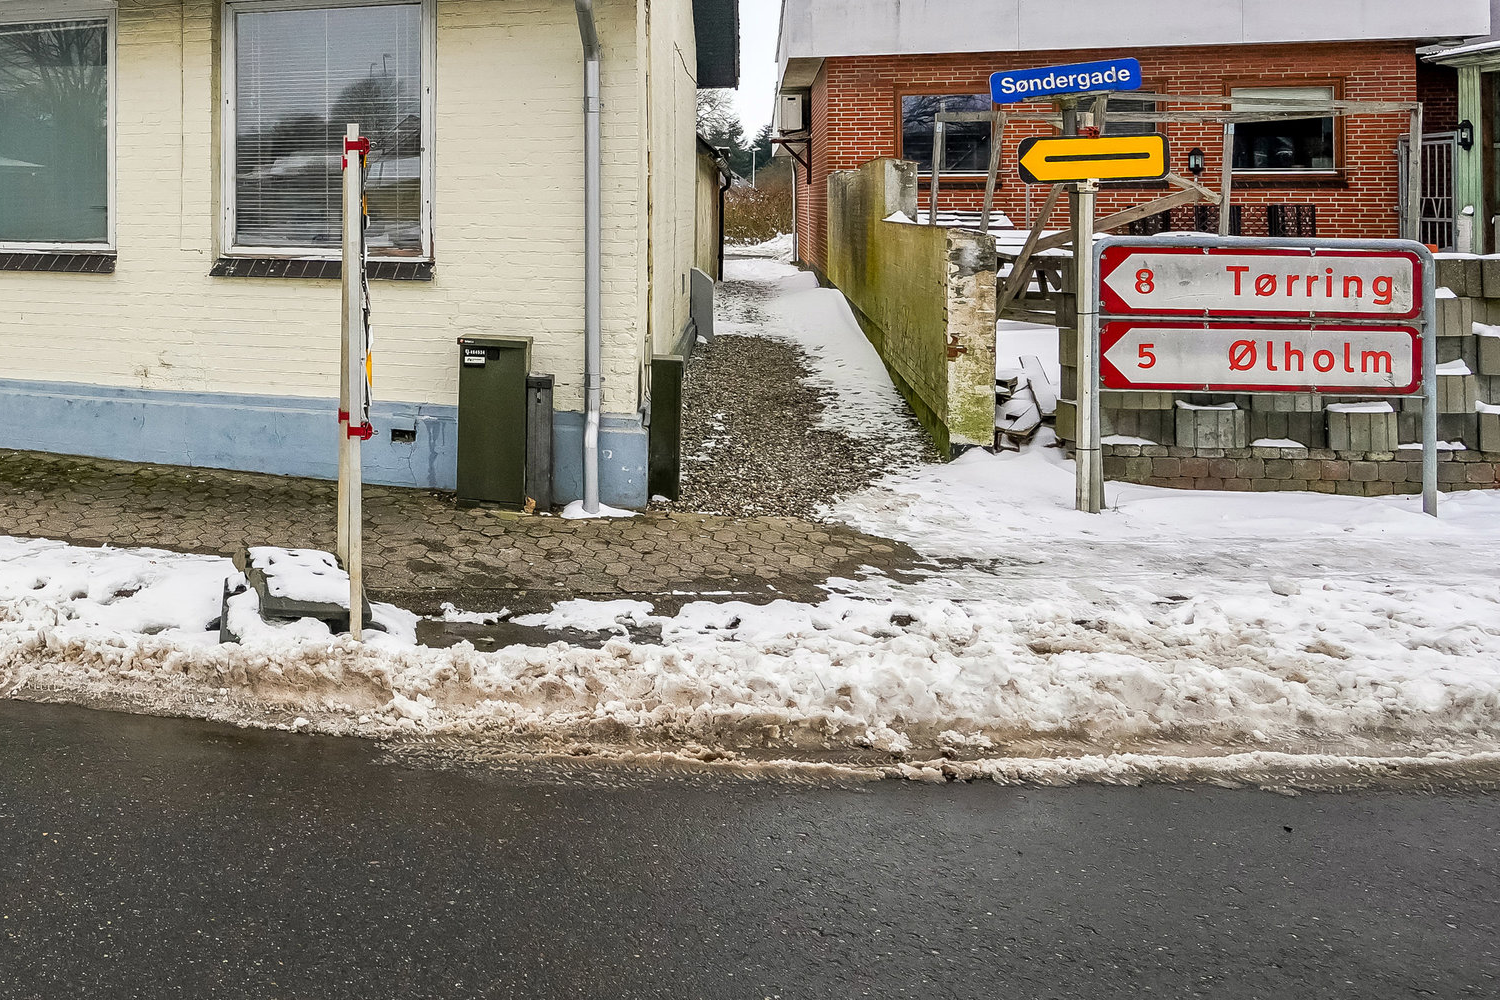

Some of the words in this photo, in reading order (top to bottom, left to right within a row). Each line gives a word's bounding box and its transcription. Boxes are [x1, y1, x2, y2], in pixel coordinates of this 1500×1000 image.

[1001, 66, 1131, 94] Søndergade
[1134, 268, 1155, 294] 8
[1226, 265, 1393, 305] Tørring
[1137, 343, 1156, 368] 5
[1228, 339, 1393, 373] Ølholm
